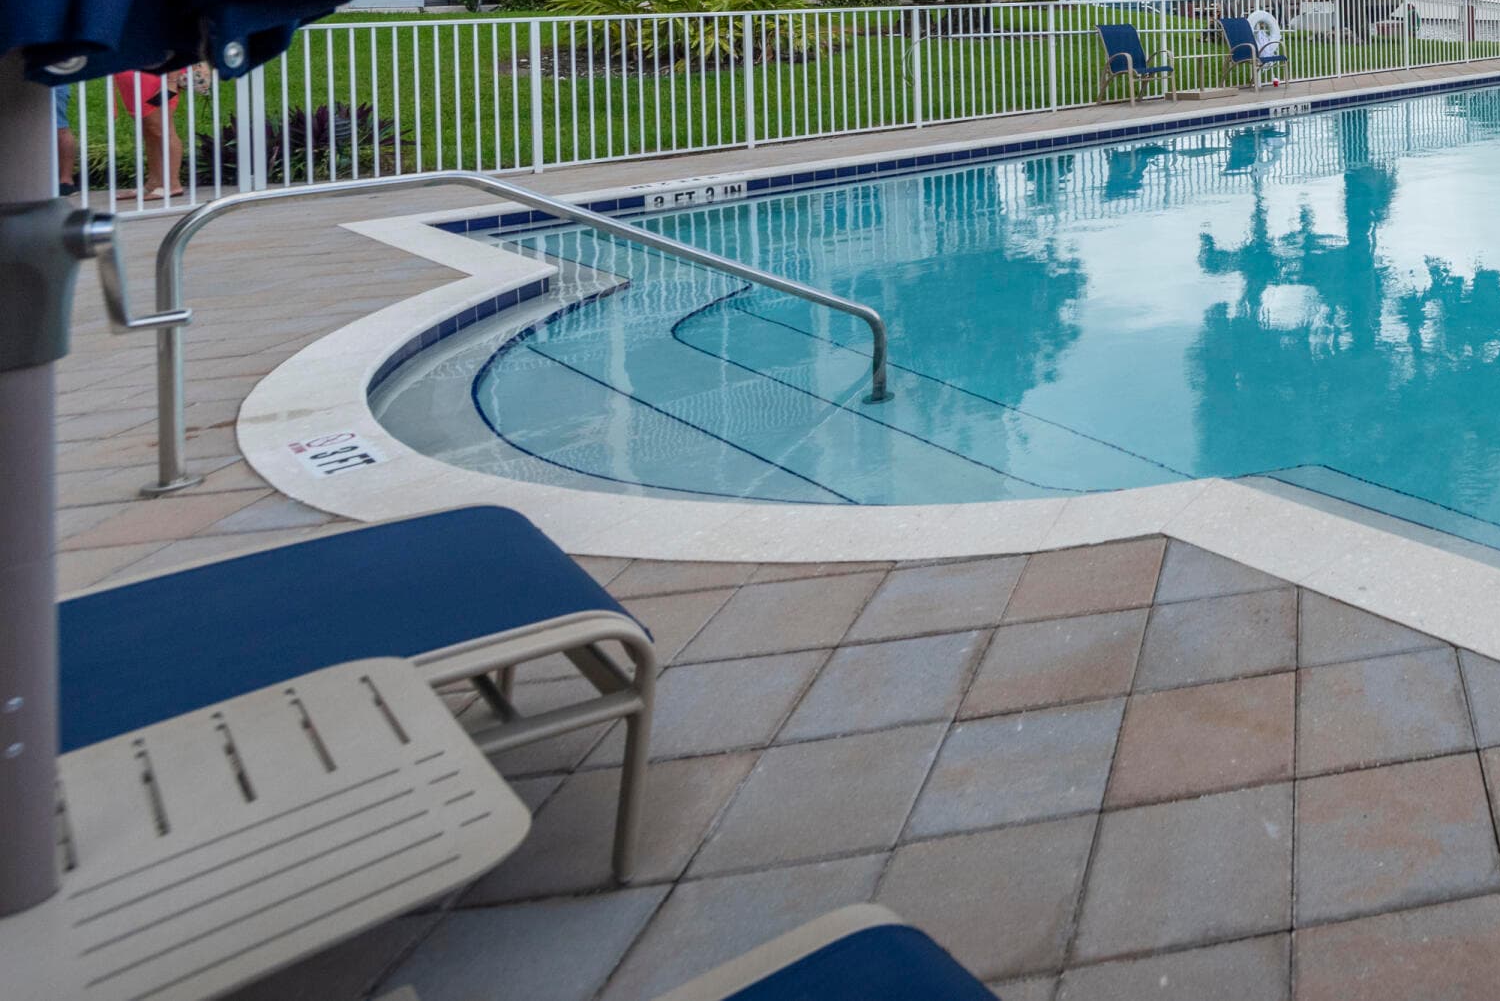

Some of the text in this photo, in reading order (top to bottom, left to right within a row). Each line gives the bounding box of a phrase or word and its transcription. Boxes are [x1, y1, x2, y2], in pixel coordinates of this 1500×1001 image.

[674, 191, 696, 205] FT
[724, 184, 742, 198] IN
[309, 445, 359, 460] 3
